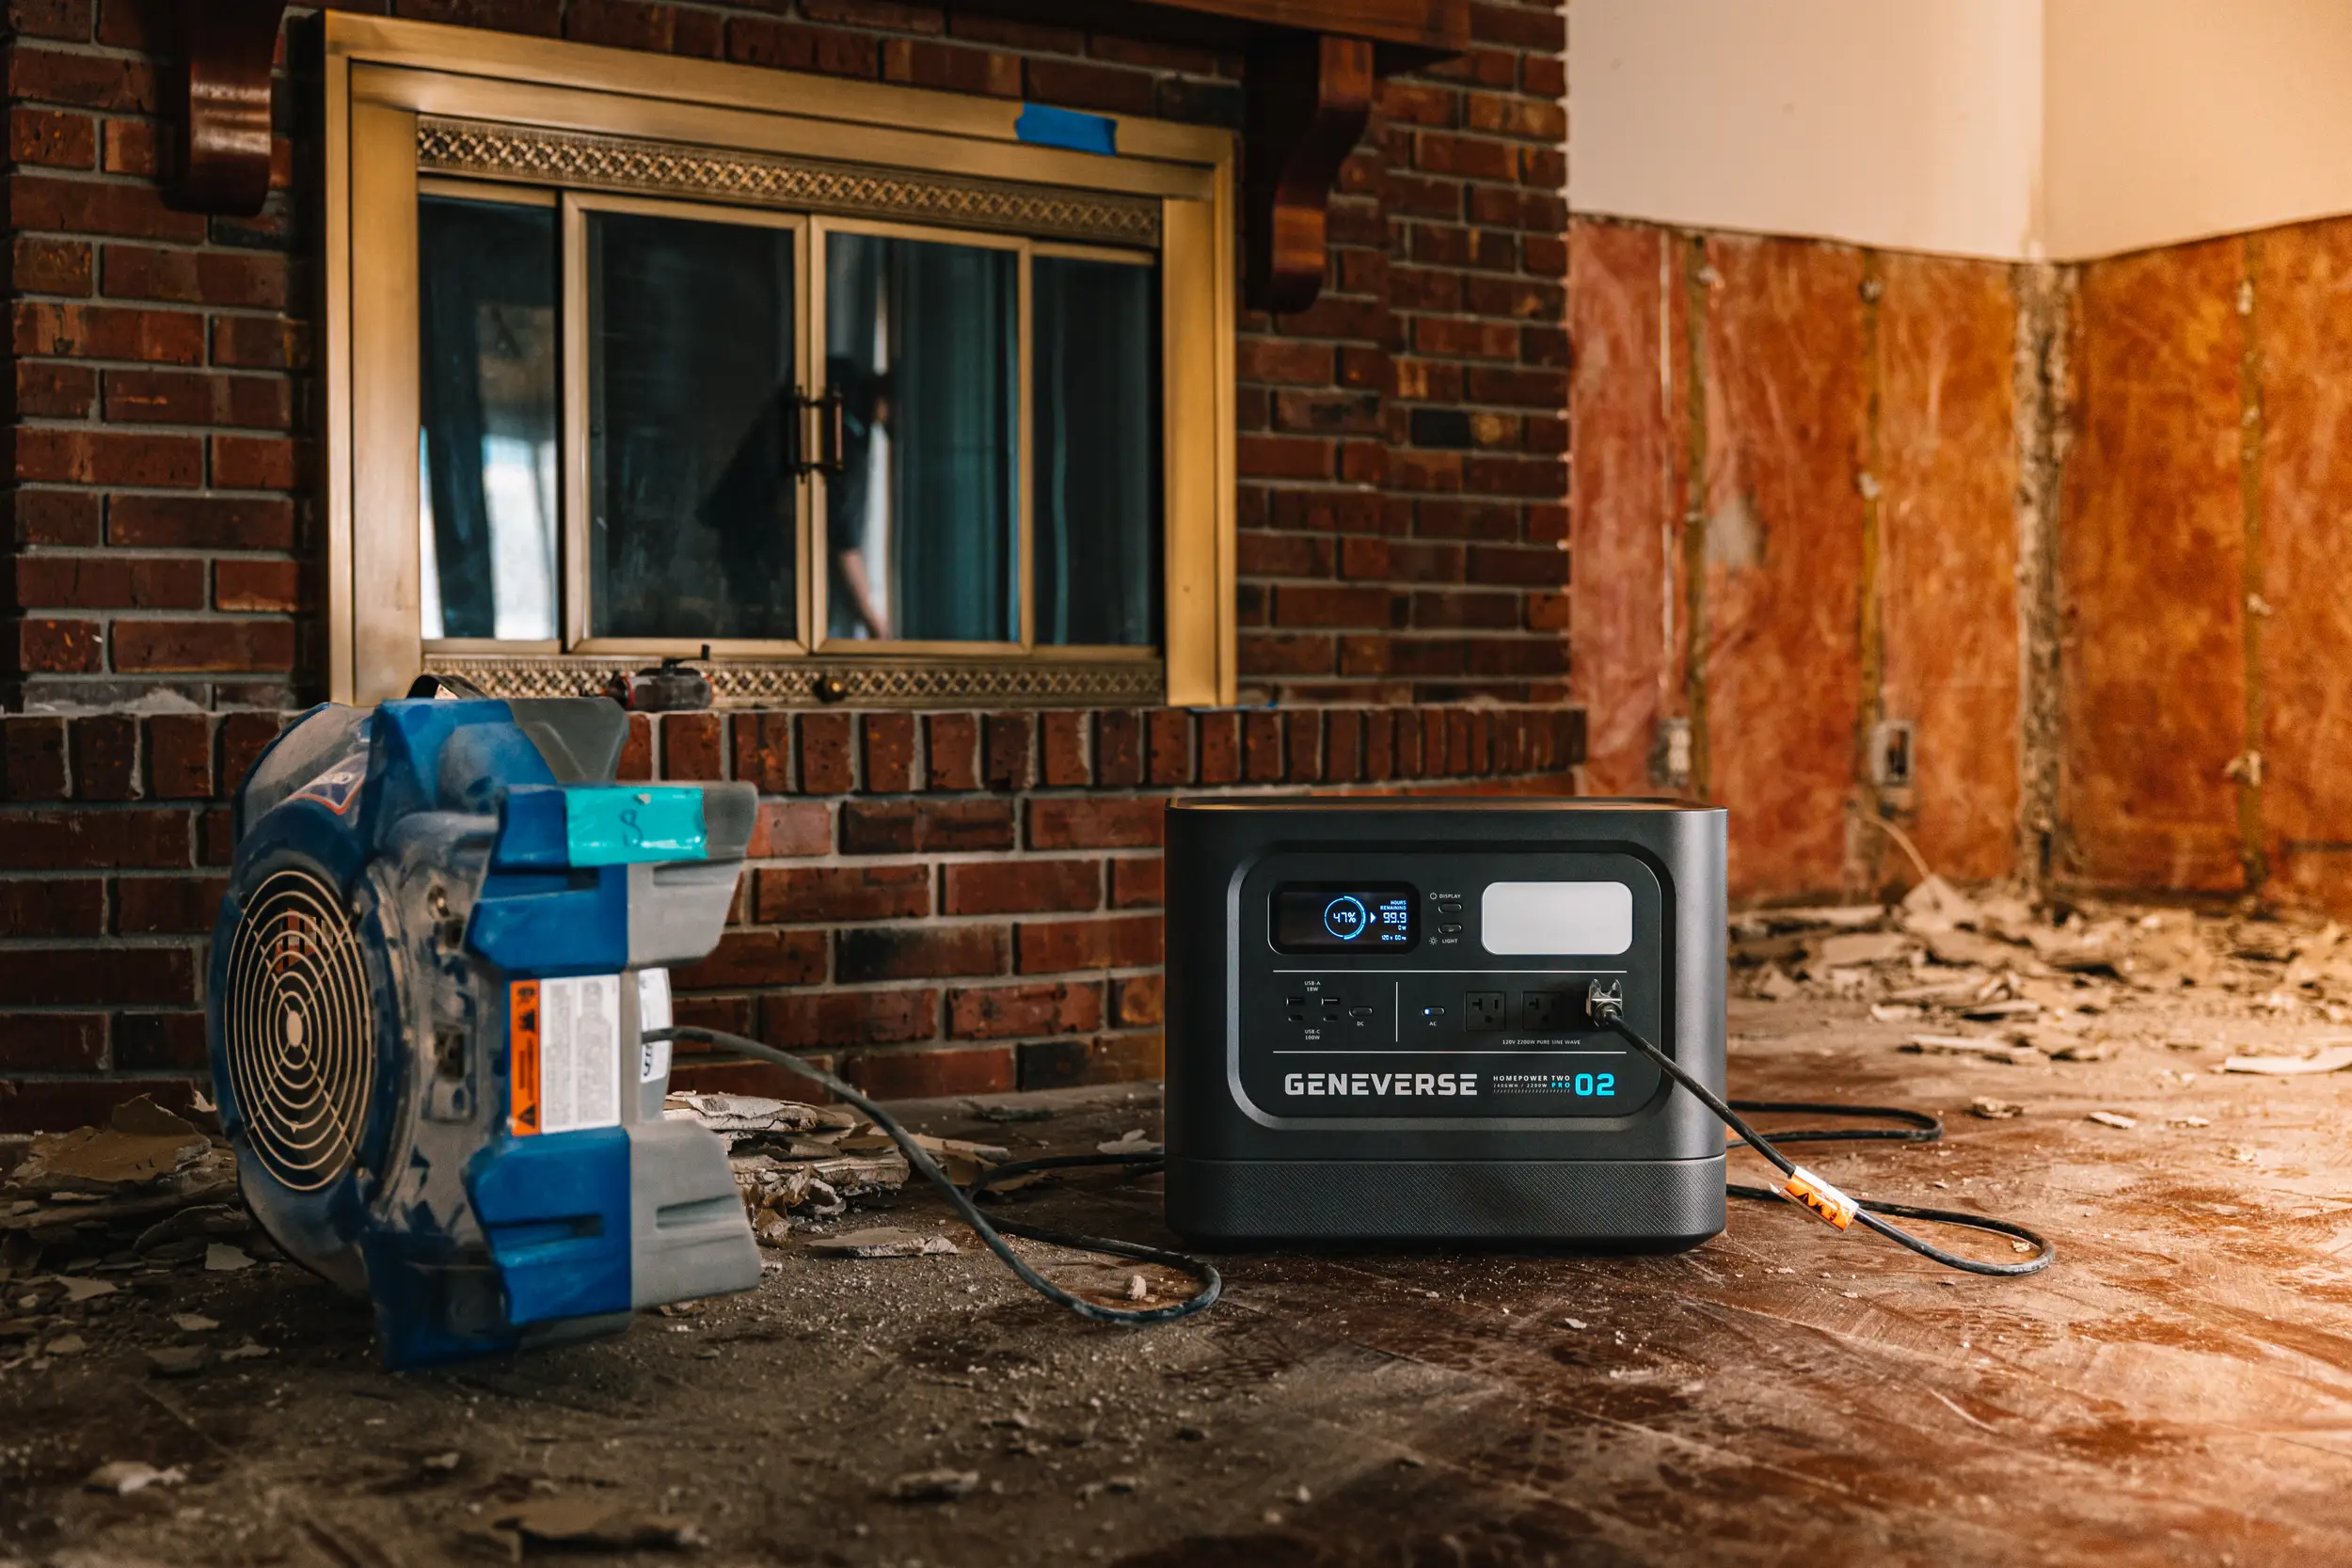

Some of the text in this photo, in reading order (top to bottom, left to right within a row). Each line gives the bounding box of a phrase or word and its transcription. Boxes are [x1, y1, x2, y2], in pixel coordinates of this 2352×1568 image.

[1332, 911, 1357, 924] 47%
[1383, 911, 1406, 924] 99.9
[1284, 1073, 1478, 1096] GENEVERSE
[1575, 1073, 1615, 1096] 02
